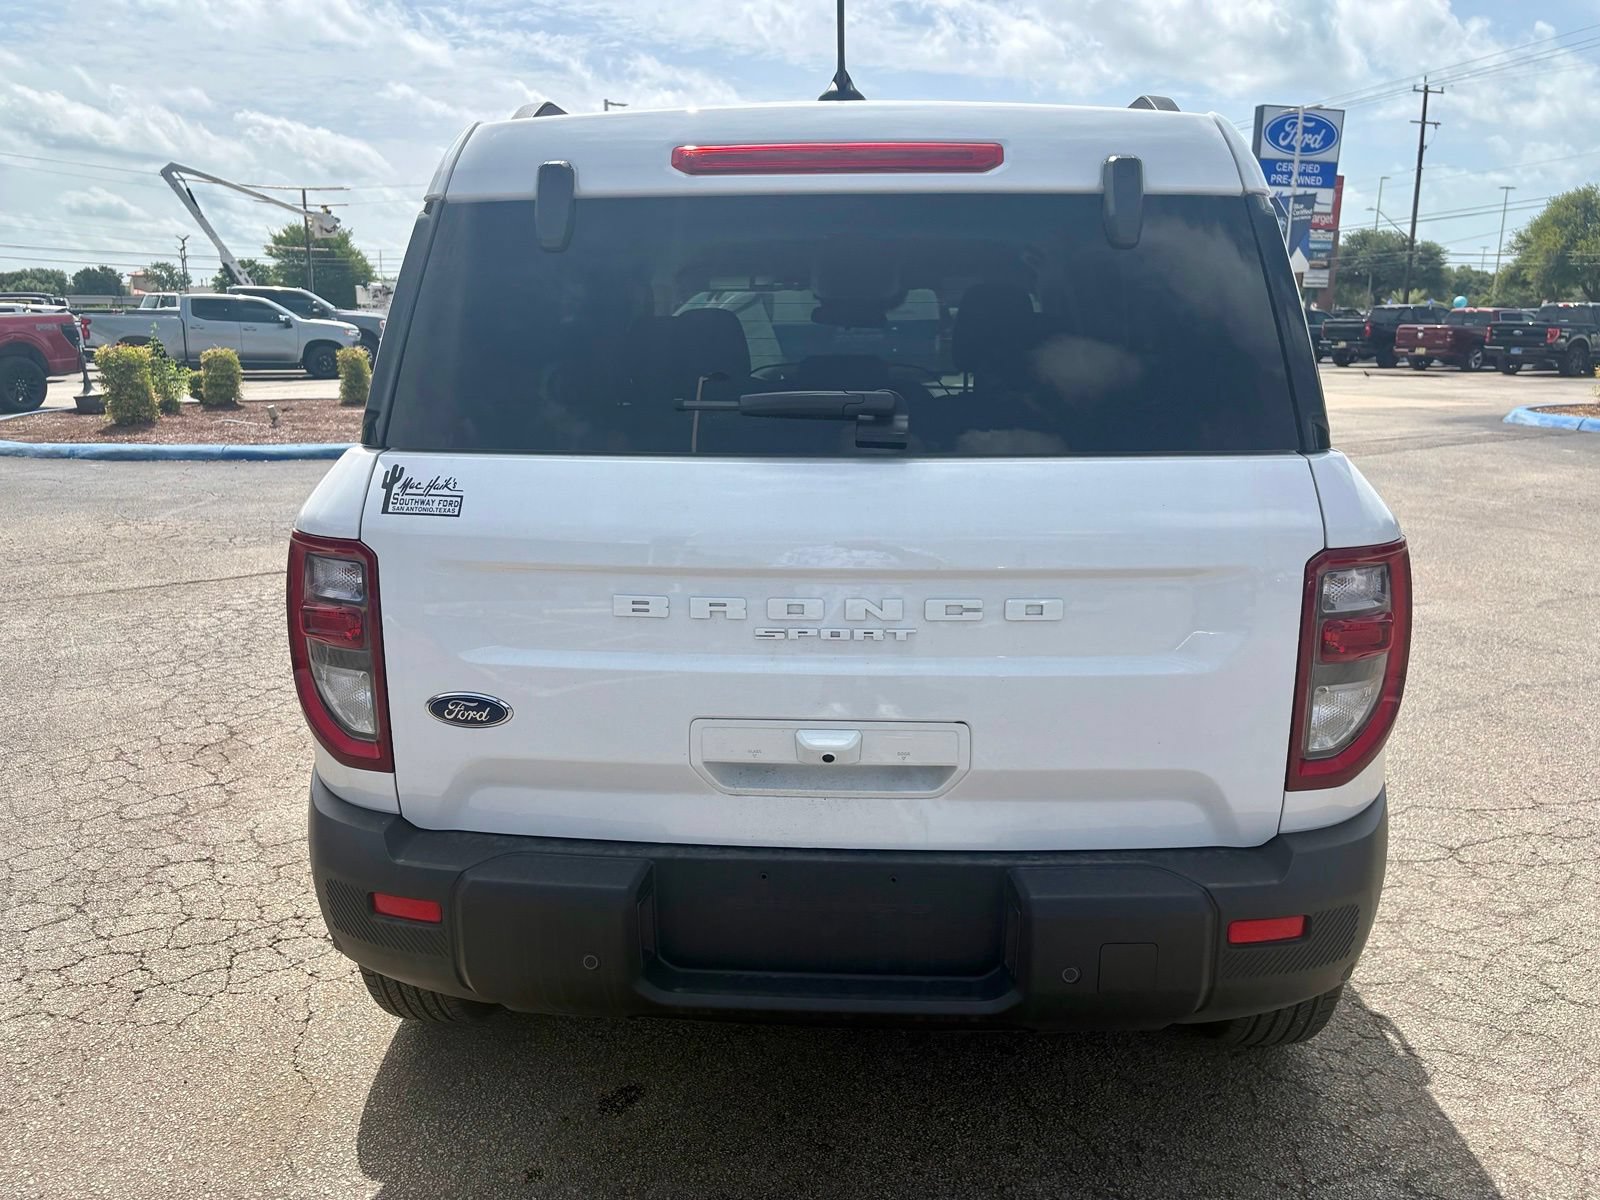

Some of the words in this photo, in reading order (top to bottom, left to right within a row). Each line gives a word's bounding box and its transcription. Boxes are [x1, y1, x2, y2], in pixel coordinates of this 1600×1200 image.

[1279, 119, 1326, 149] Frd
[1276, 162, 1320, 173] CERFIED
[1312, 214, 1333, 226] arget
[398, 476, 424, 496] Mac
[423, 475, 464, 497] Haik's
[391, 493, 436, 507] SOUTHWAY
[437, 499, 460, 508] FORD
[612, 594, 1064, 621] BRONCO
[754, 627, 917, 641] SPORT
[444, 700, 490, 721] Ford
